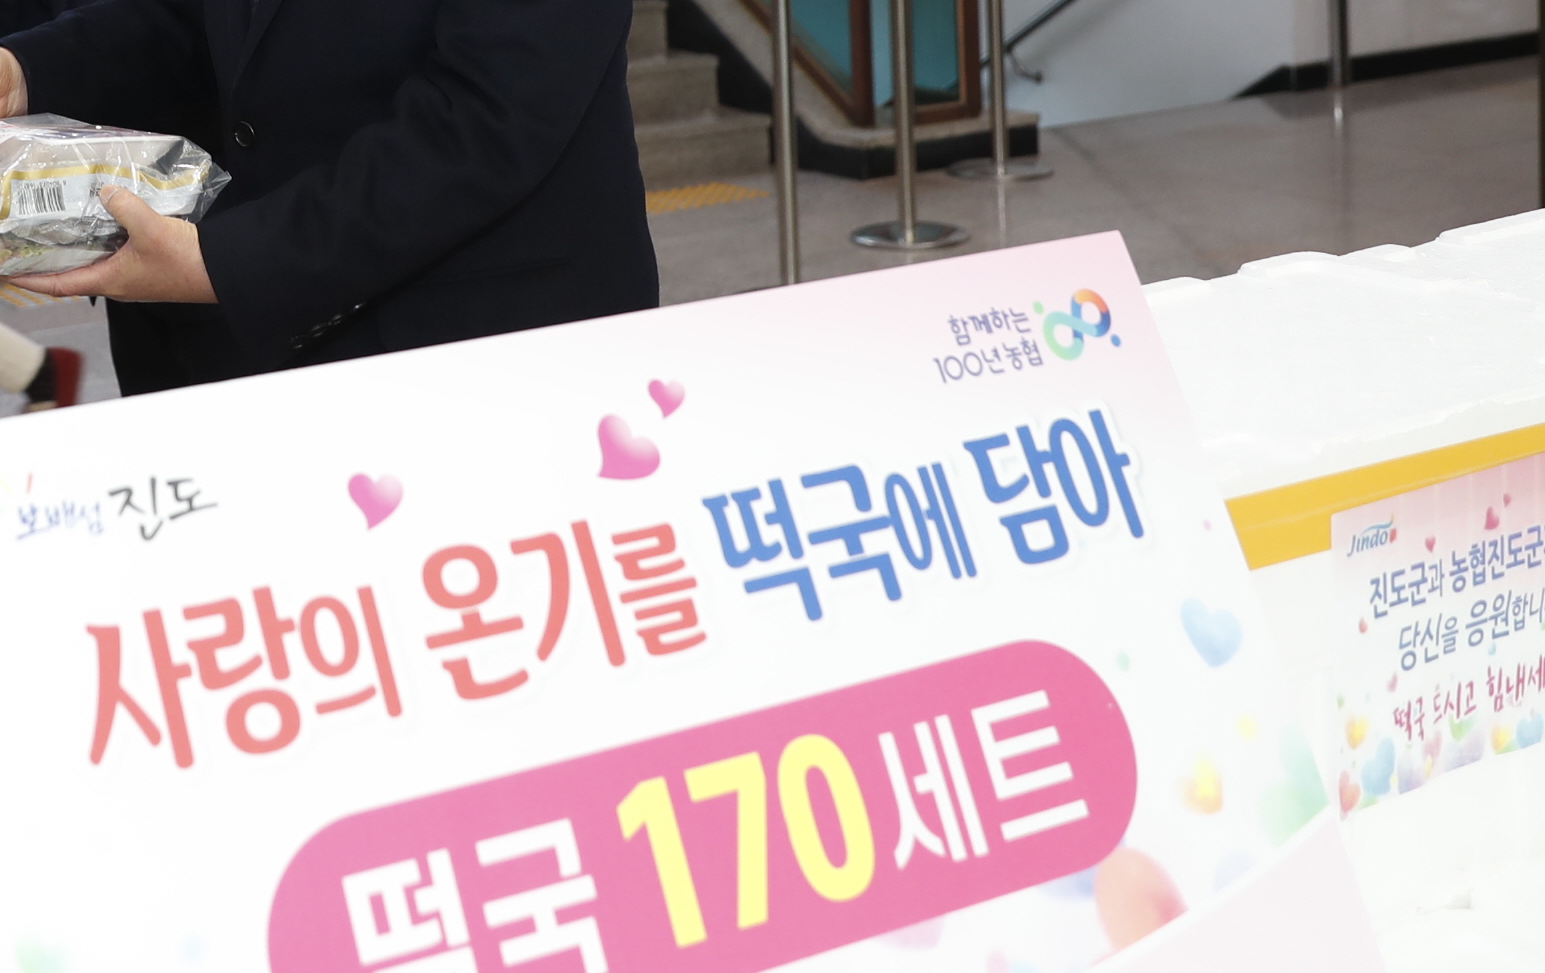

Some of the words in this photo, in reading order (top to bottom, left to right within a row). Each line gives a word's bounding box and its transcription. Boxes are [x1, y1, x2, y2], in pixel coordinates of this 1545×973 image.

[947, 306, 1032, 346] 함께하는
[108, 476, 218, 541] 진도
[85, 586, 402, 769] 사랑의
[422, 519, 707, 701] 온기를
[701, 462, 978, 622] 떡국에
[962, 408, 1145, 565] 담아
[1369, 557, 1445, 620] 진도군과
[1449, 524, 1545, 593] 농협진도군
[1398, 612, 1459, 672] 당신을
[1465, 587, 1545, 648] 응원합니
[342, 817, 609, 973] 떡국
